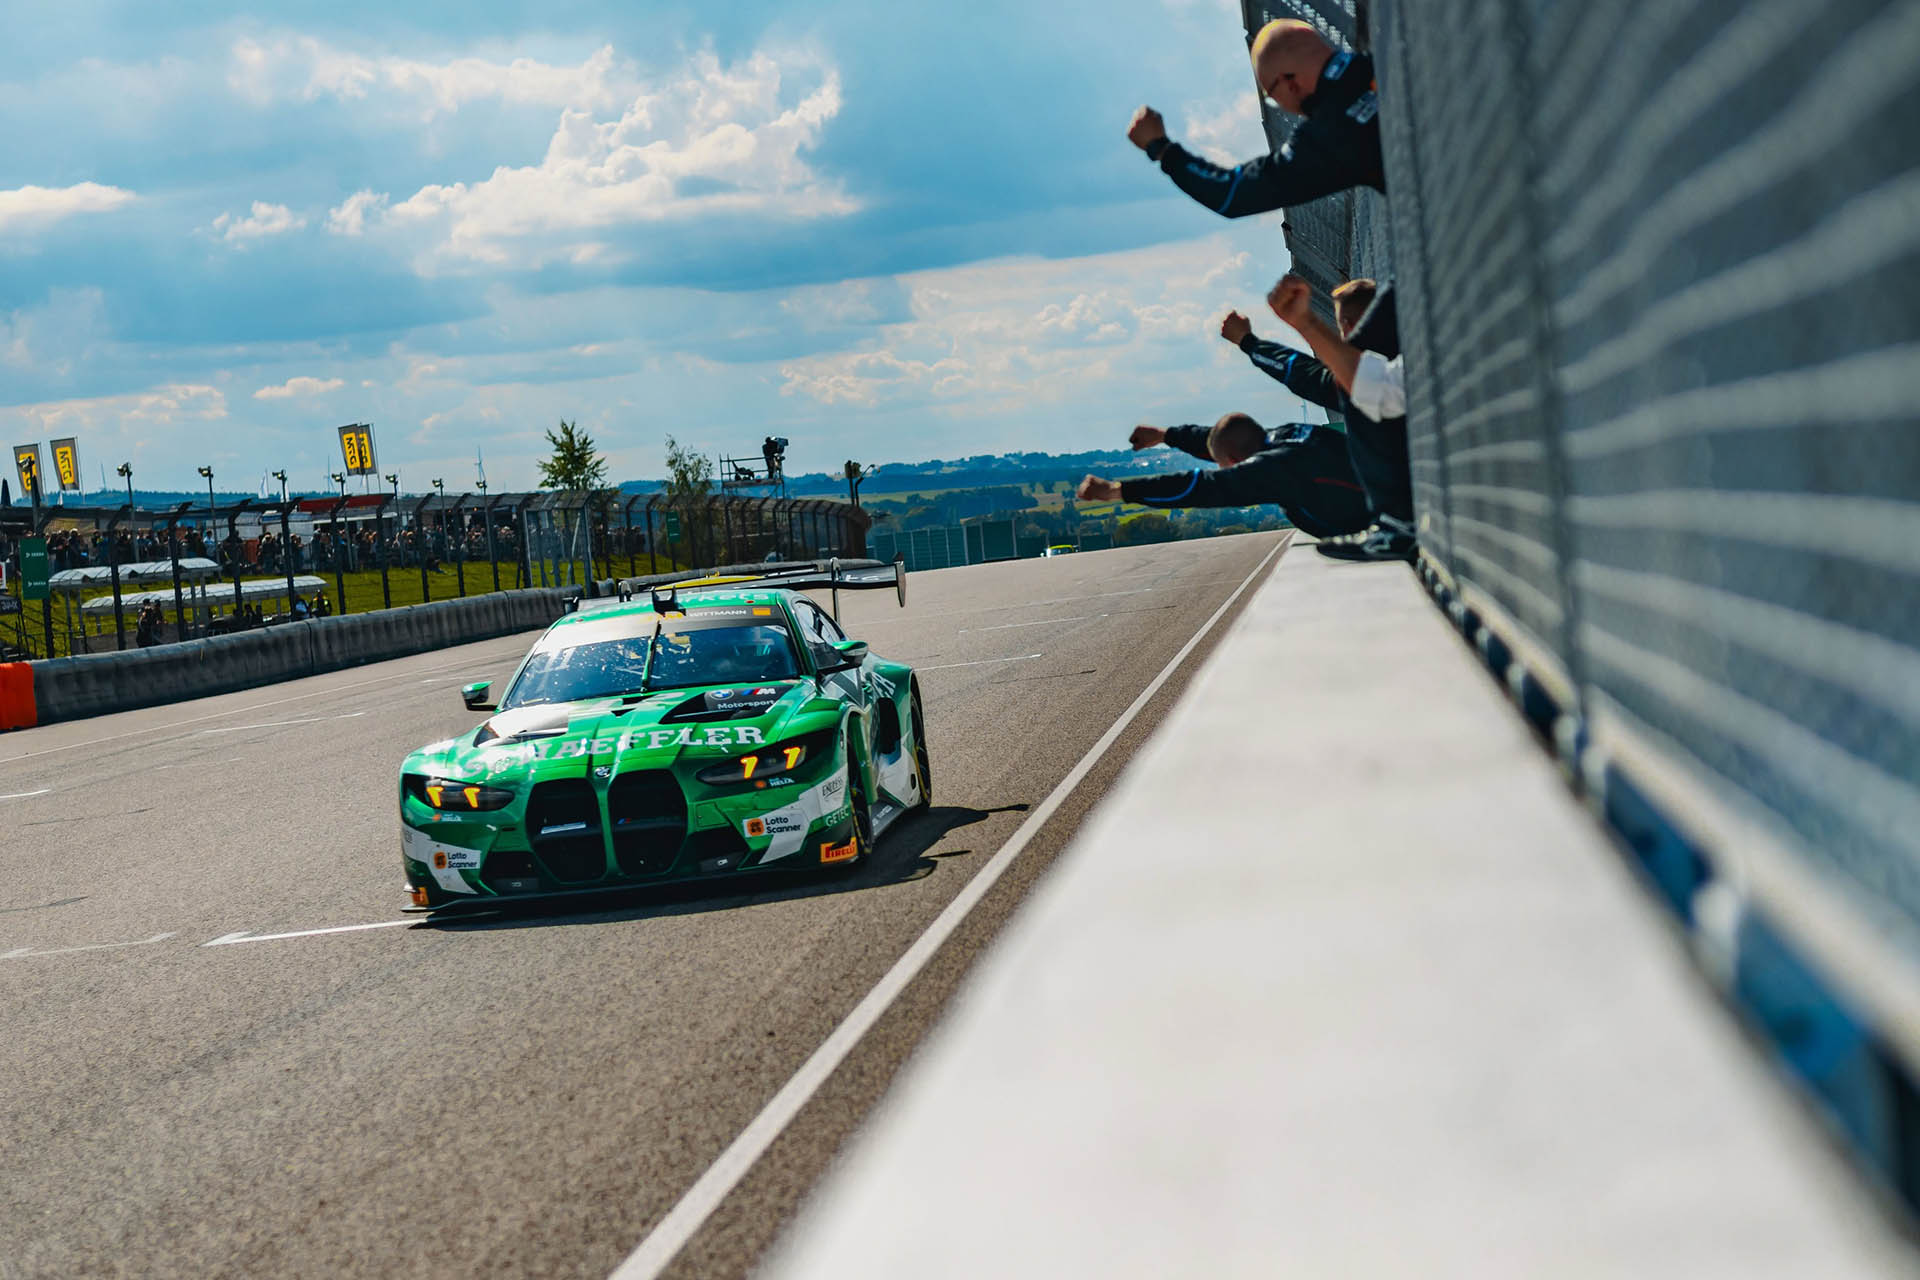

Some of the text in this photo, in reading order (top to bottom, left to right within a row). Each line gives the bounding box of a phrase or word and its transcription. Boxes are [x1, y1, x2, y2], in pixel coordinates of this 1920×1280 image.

[717, 699, 775, 710] Motorsport
[765, 816, 789, 825] Lotto
[766, 824, 801, 834] Scanner
[447, 852, 467, 860] Lotto
[447, 860, 478, 869] Scanner
